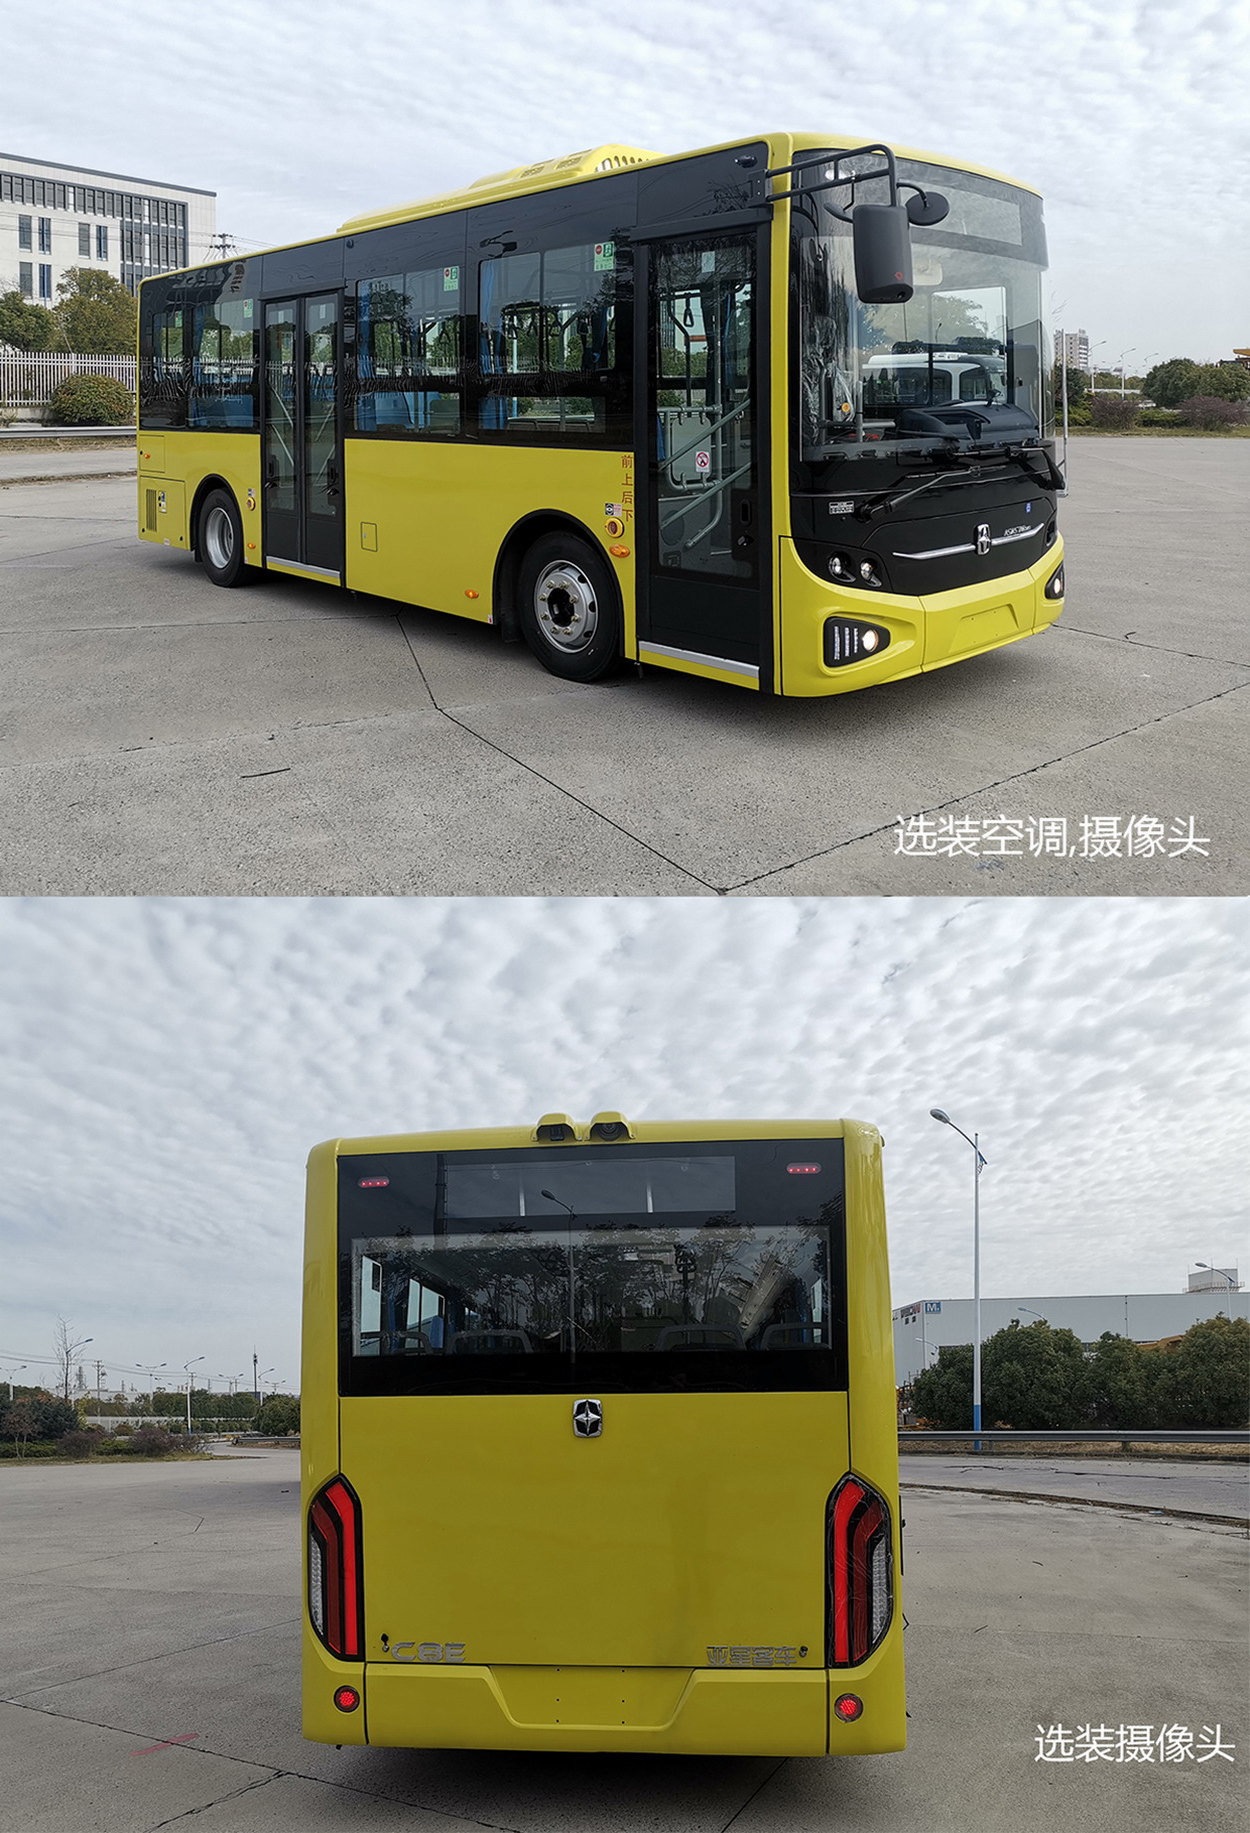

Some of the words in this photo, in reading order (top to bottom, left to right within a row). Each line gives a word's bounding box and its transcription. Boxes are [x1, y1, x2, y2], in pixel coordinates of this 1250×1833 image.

[621, 455, 633, 522] 前上后下
[391, 1642, 466, 1662] C8E
[706, 1646, 797, 1666] 亚星客车
